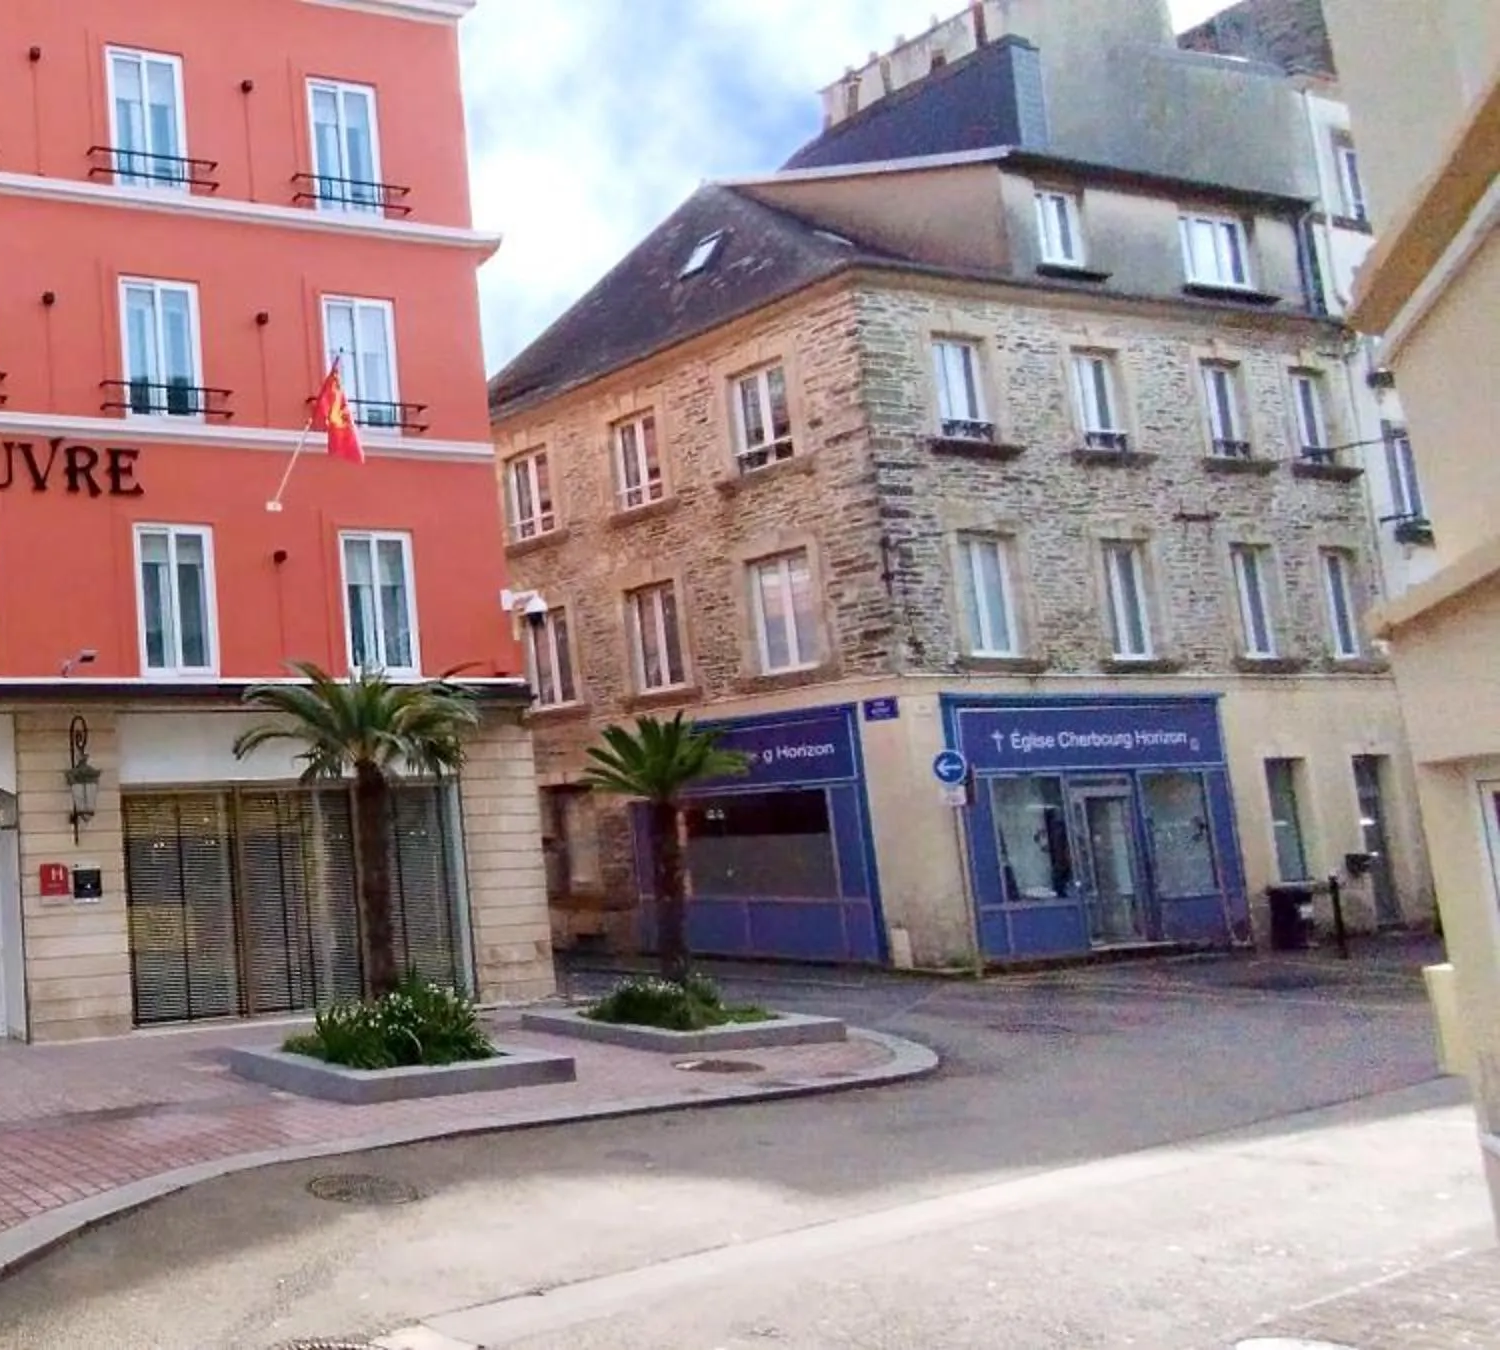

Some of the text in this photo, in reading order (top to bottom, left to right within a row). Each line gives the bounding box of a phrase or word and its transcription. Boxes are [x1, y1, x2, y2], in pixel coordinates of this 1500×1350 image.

[1058, 730, 1132, 749] Cherbourg
[1133, 729, 1187, 745] Horizon
[776, 743, 835, 759] Horizon
